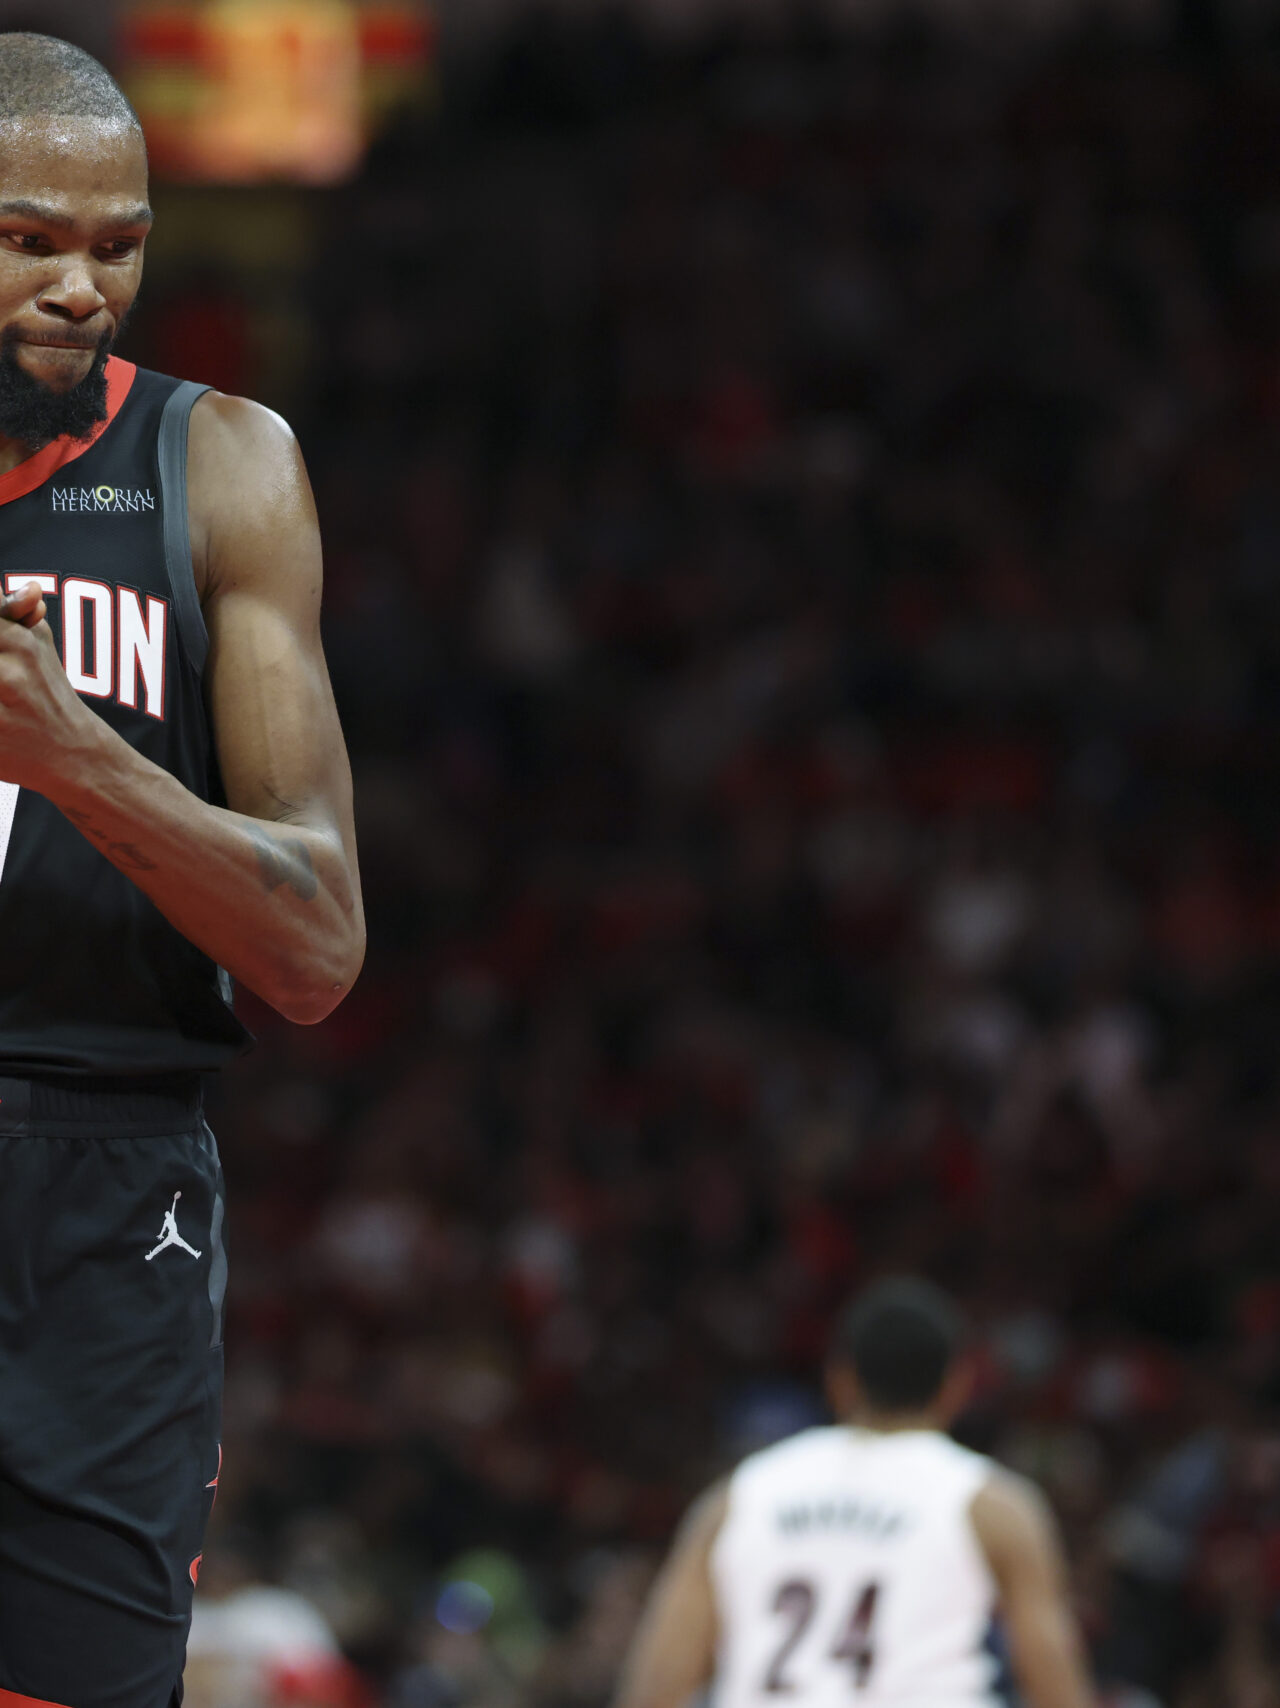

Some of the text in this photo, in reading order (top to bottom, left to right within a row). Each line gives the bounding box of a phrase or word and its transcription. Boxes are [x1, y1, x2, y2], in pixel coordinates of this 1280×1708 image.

[52, 485, 156, 502] MEMORIAL
[52, 498, 155, 512] HERMANN
[762, 1576, 881, 1694] 24
